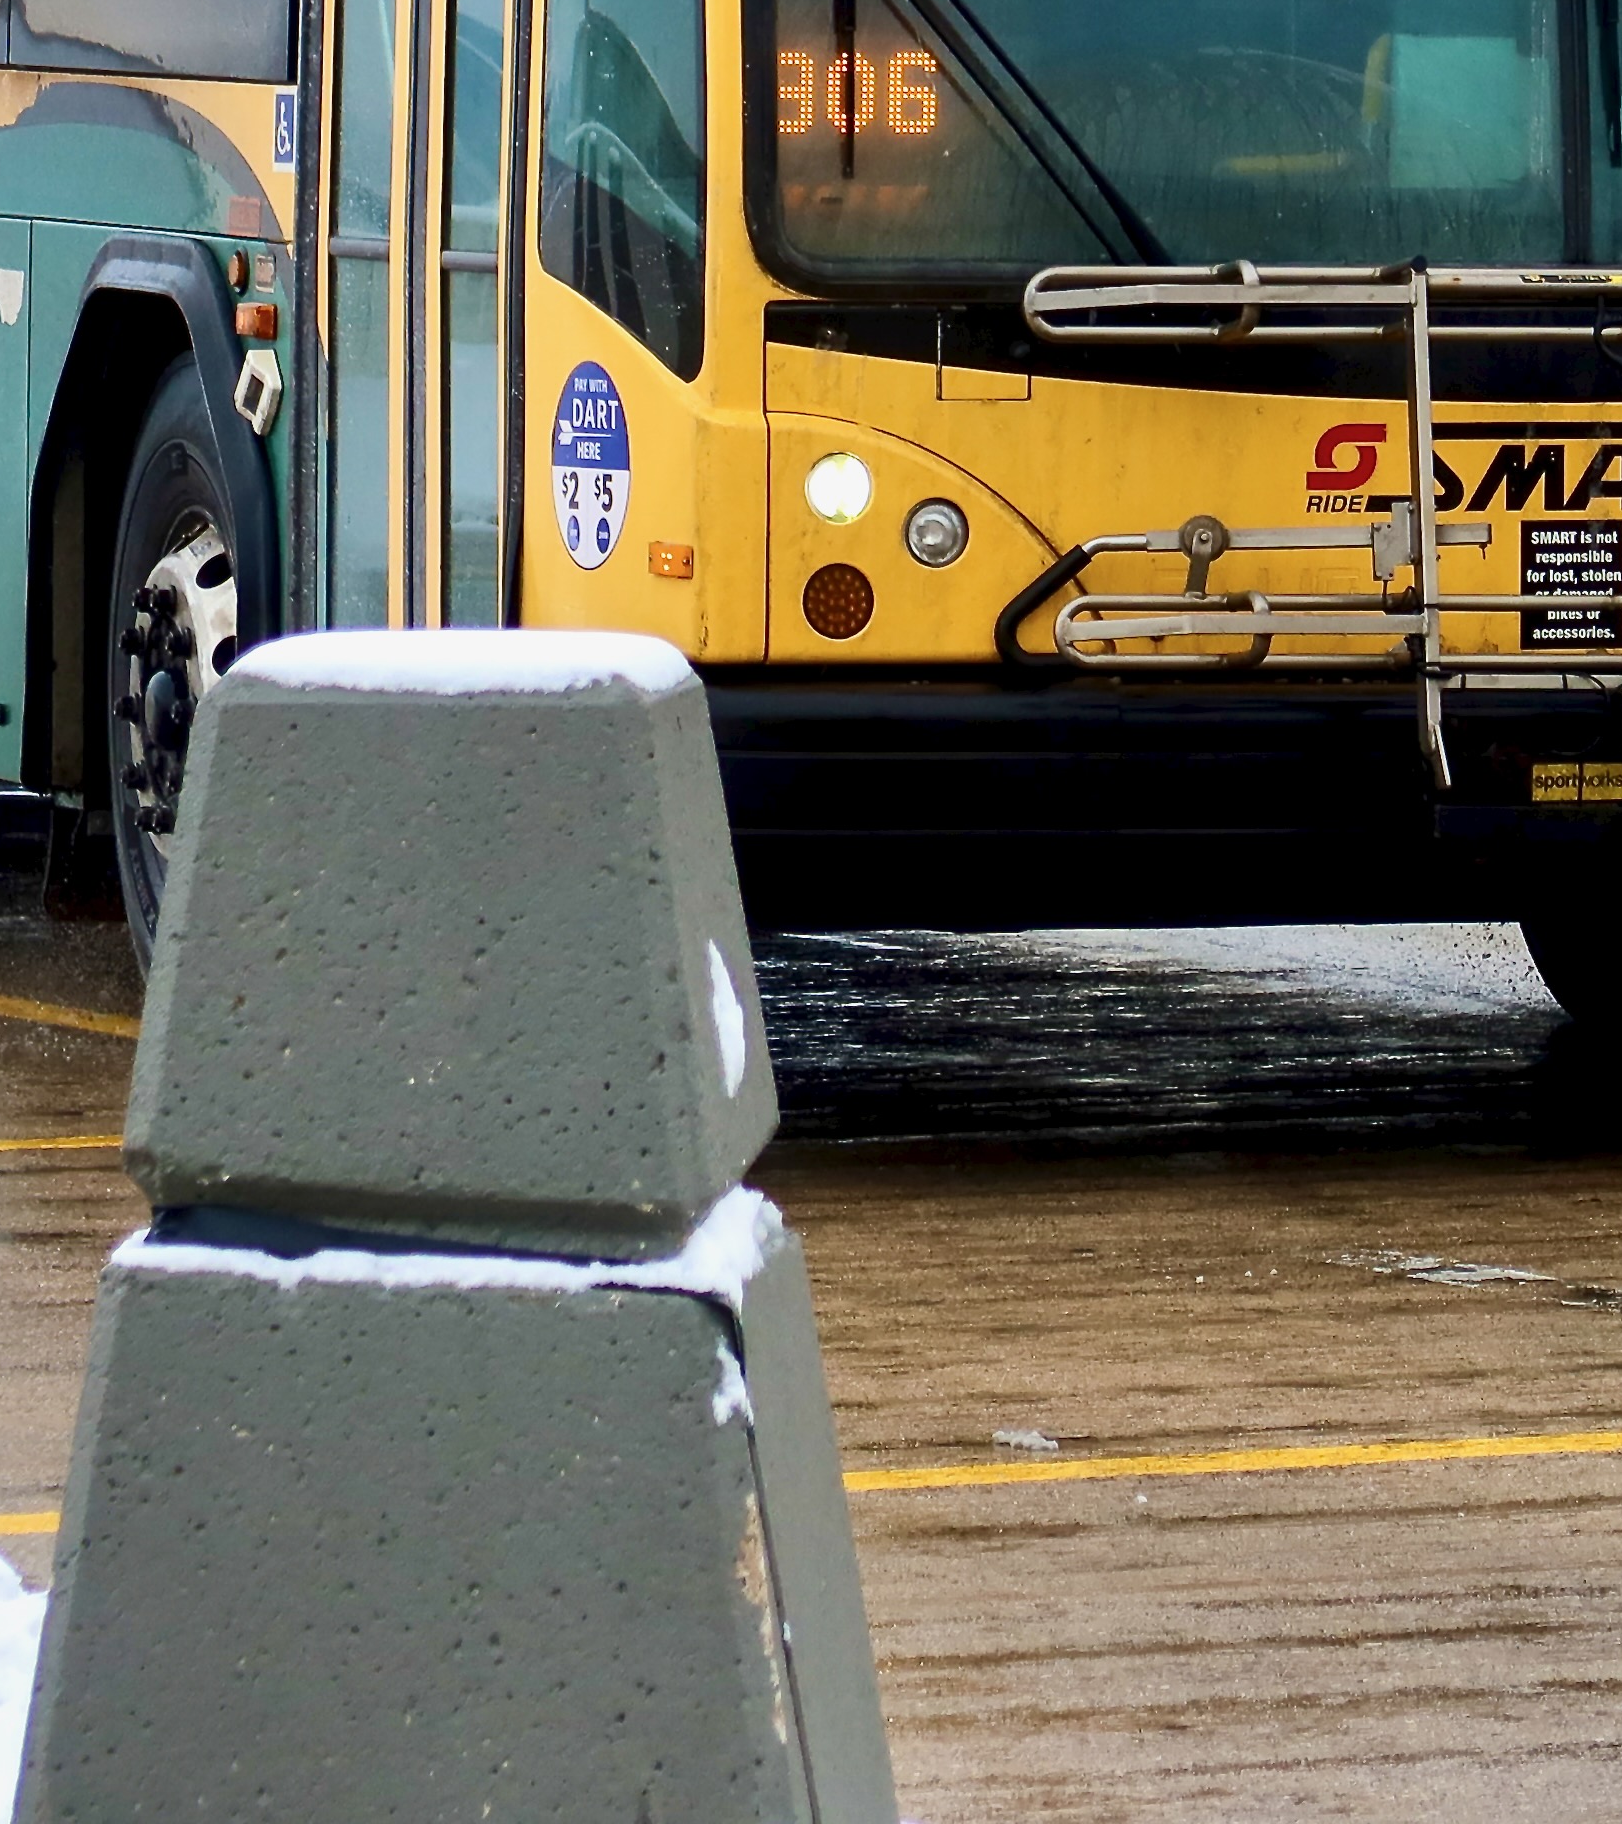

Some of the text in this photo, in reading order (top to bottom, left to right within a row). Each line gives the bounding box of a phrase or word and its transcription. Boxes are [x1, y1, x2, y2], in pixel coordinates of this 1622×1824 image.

[574, 378, 608, 393] PAY WITH
[572, 398, 619, 430] DART
[576, 441, 601, 461] HERE
[562, 471, 613, 513] $2 $5
[1305, 494, 1365, 514] RIDE
[1531, 530, 1618, 545] SMART is not
[1535, 550, 1613, 566] responsible
[1526, 569, 1622, 585] for lost, stolen
[1532, 626, 1615, 639] accessories.
